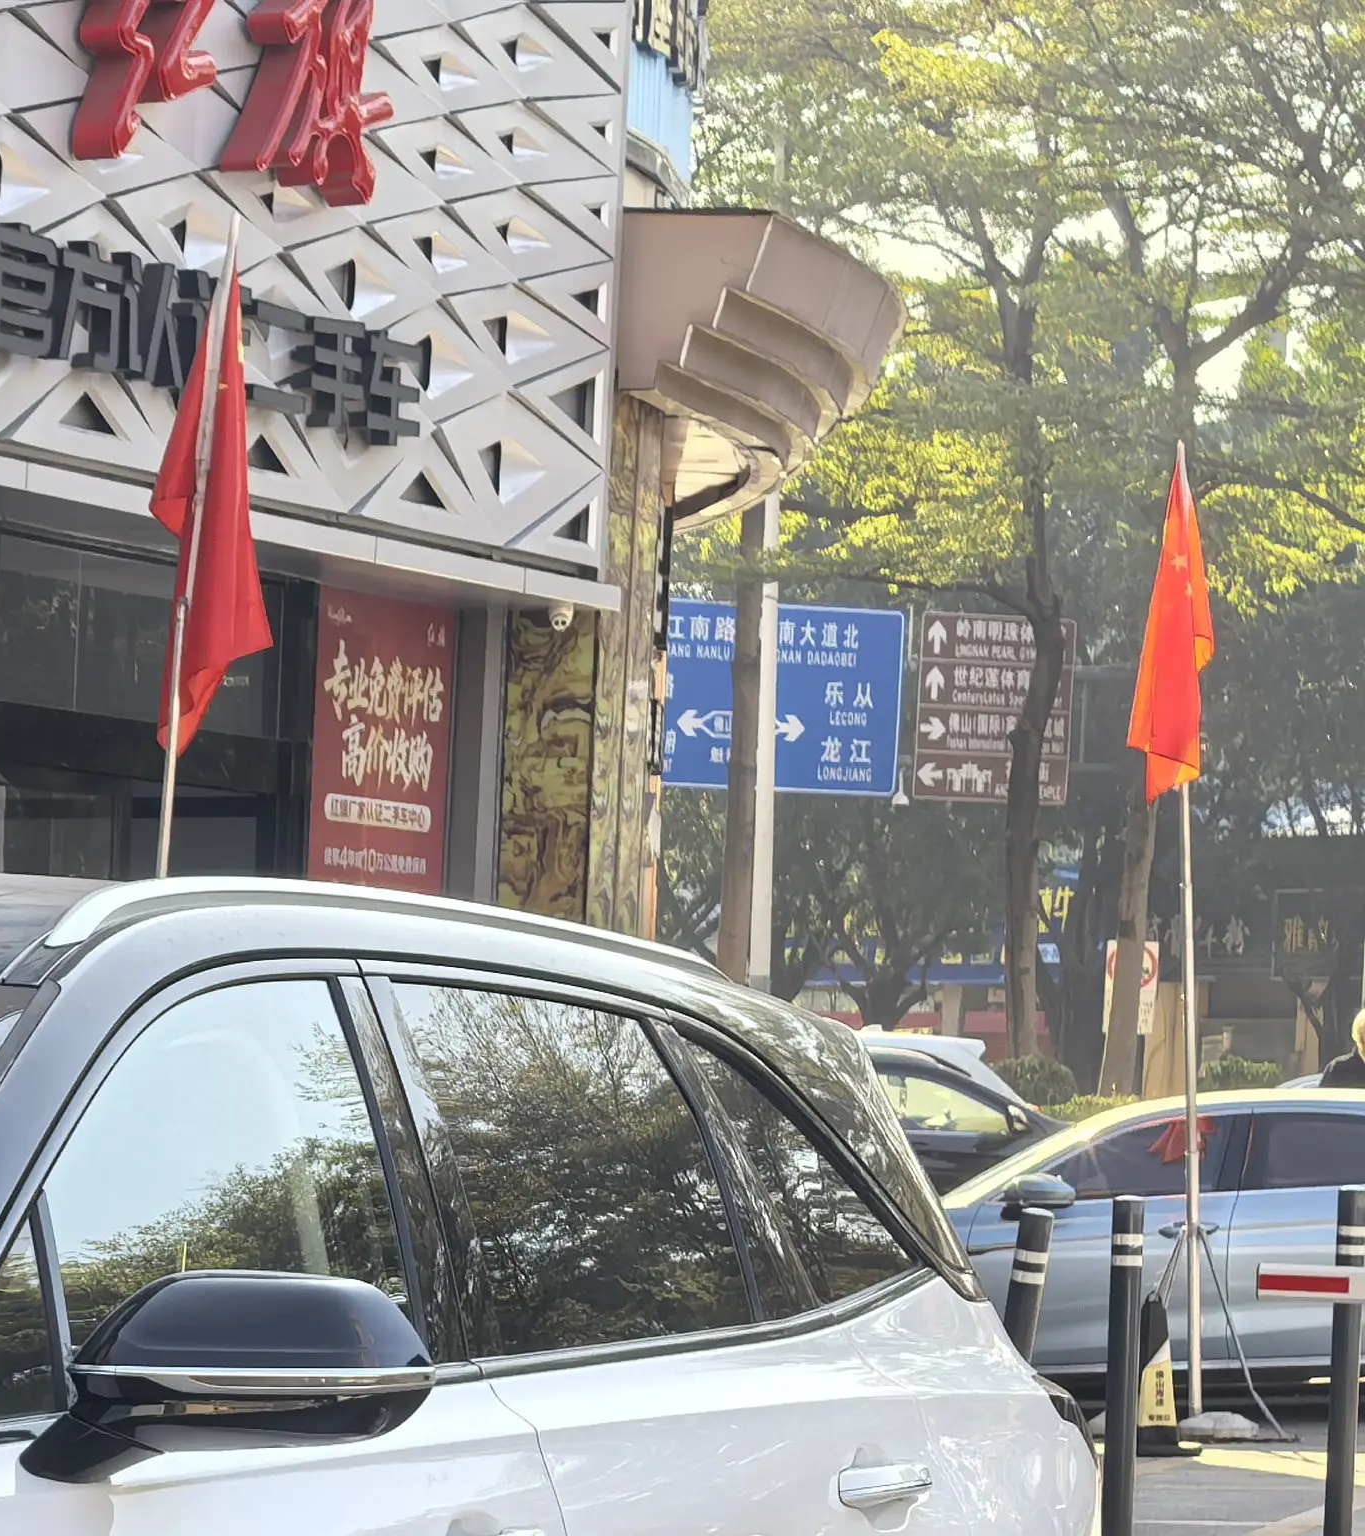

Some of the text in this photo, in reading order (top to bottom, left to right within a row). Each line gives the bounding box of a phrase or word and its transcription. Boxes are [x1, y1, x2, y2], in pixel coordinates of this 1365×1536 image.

[779, 618, 859, 650] 南大道北
[824, 681, 874, 709] 乐从
[341, 713, 433, 793] 高价收购
[820, 735, 872, 764] 龙江
